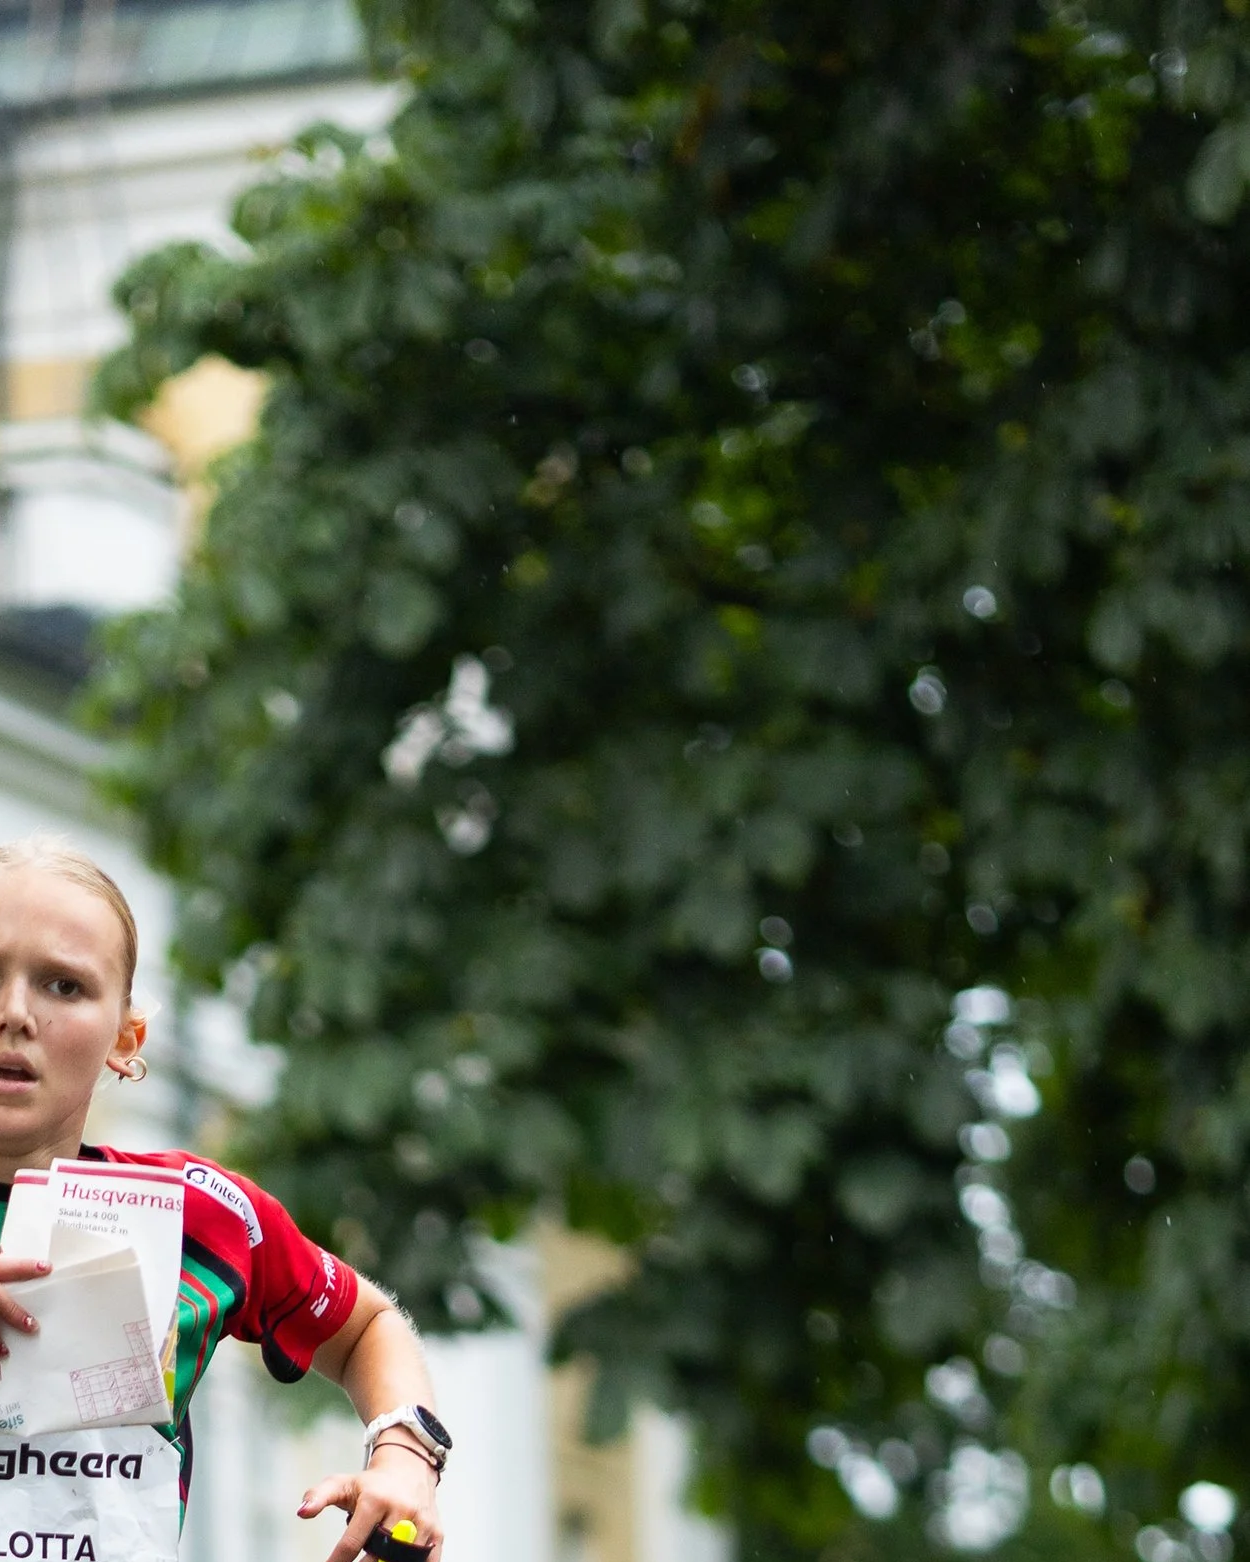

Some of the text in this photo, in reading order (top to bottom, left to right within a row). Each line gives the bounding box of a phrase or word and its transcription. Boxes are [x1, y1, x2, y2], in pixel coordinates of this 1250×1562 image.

[62, 1182, 182, 1212] Husqvarnas
[58, 1207, 82, 1218] Skala
[101, 1211, 120, 1222] 000
[110, 1225, 118, 1234] 2
